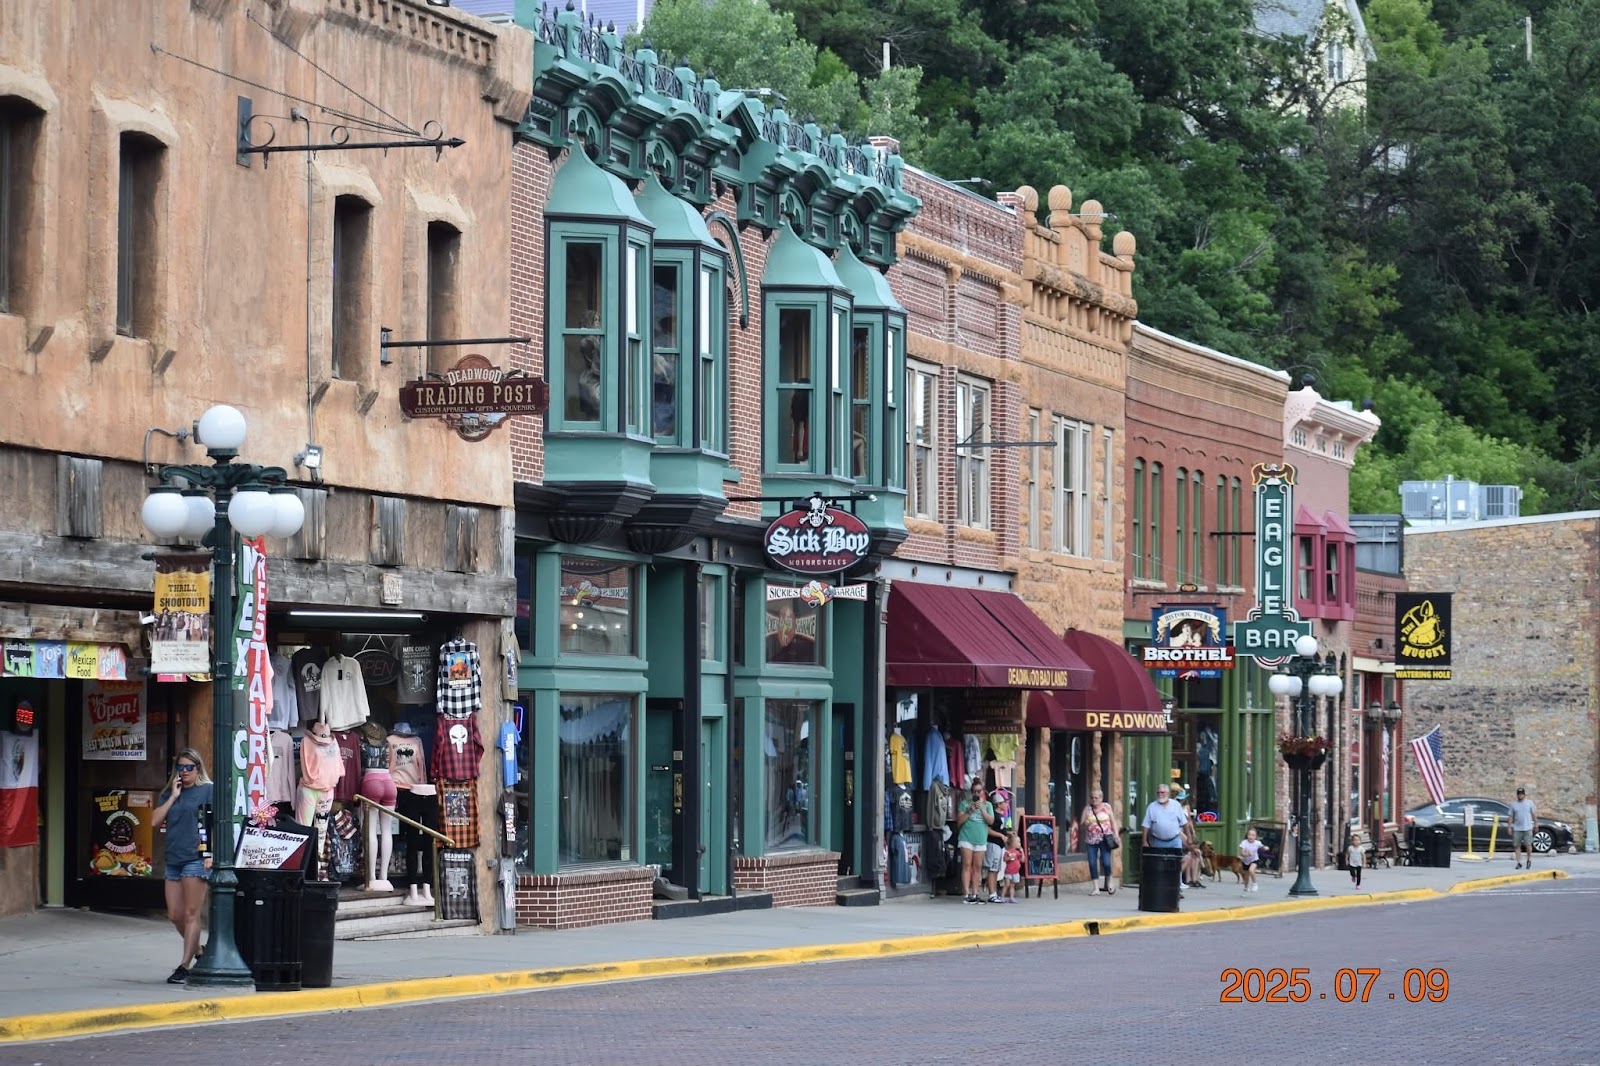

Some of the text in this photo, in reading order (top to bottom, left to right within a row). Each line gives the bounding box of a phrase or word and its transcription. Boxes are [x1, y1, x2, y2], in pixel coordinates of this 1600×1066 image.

[447, 368, 502, 386] DEADWOOD
[416, 385, 533, 406] TRADING POST
[767, 527, 869, 557] Sick Boy
[1264, 498, 1282, 615] EAGLE
[168, 584, 197, 592] THRILL
[769, 586, 865, 599] SICKIES GARAGE
[160, 597, 205, 608] SHOOTOUT!
[1164, 612, 1191, 621] HISTORIC
[1401, 622, 1416, 636] THE
[1246, 629, 1298, 648] BAR
[1144, 647, 1232, 661] BROTHEL
[1401, 644, 1446, 659] NUGGET
[72, 655, 97, 666] Mexican
[77, 666, 91, 677] Food
[1040, 669, 1051, 687] BAD
[1051, 670, 1068, 687] LANDS
[1396, 671, 1451, 679] WATERING HOLE
[247, 553, 268, 817] RESTAURA
[233, 545, 257, 852] MEXCA
[97, 698, 137, 721] Open!
[1086, 712, 1166, 729] DEADWOOD
[245, 828, 304, 843] Mr. GoodStores
[242, 848, 267, 856] Novelty
